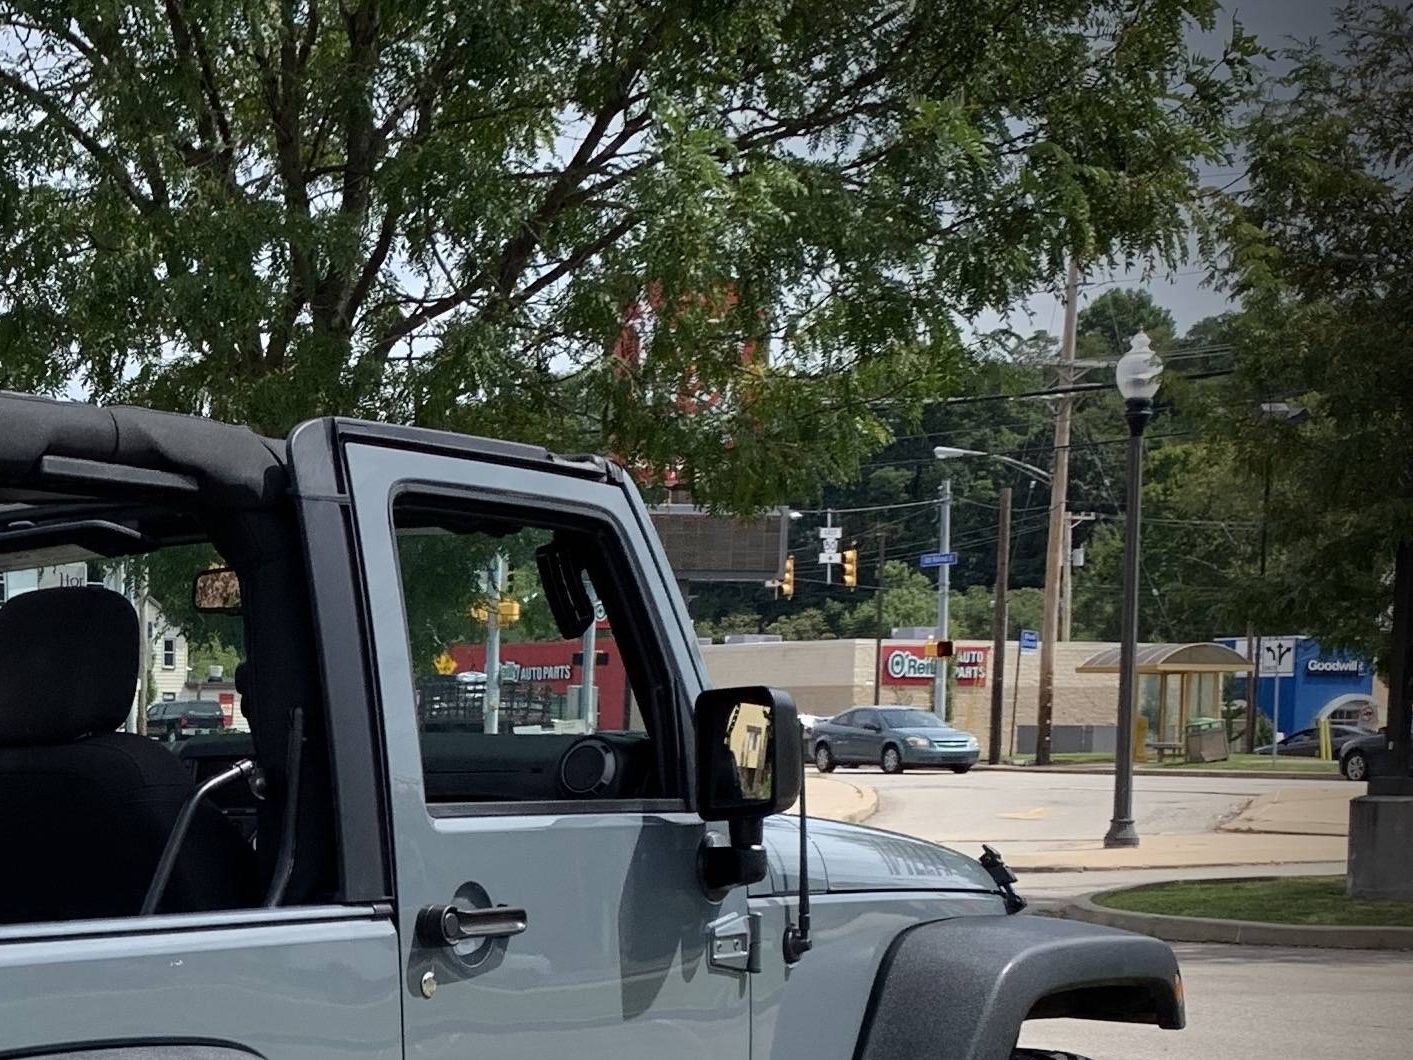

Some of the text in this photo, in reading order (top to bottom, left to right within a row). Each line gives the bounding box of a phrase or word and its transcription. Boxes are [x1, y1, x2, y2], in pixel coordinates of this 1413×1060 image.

[889, 652, 936, 676] O'Reil
[956, 650, 984, 664] AUTO
[520, 666, 543, 681] AUTO
[543, 664, 572, 680] PARTS
[954, 665, 987, 679] PARTS
[1307, 659, 1358, 672] Goodwill
